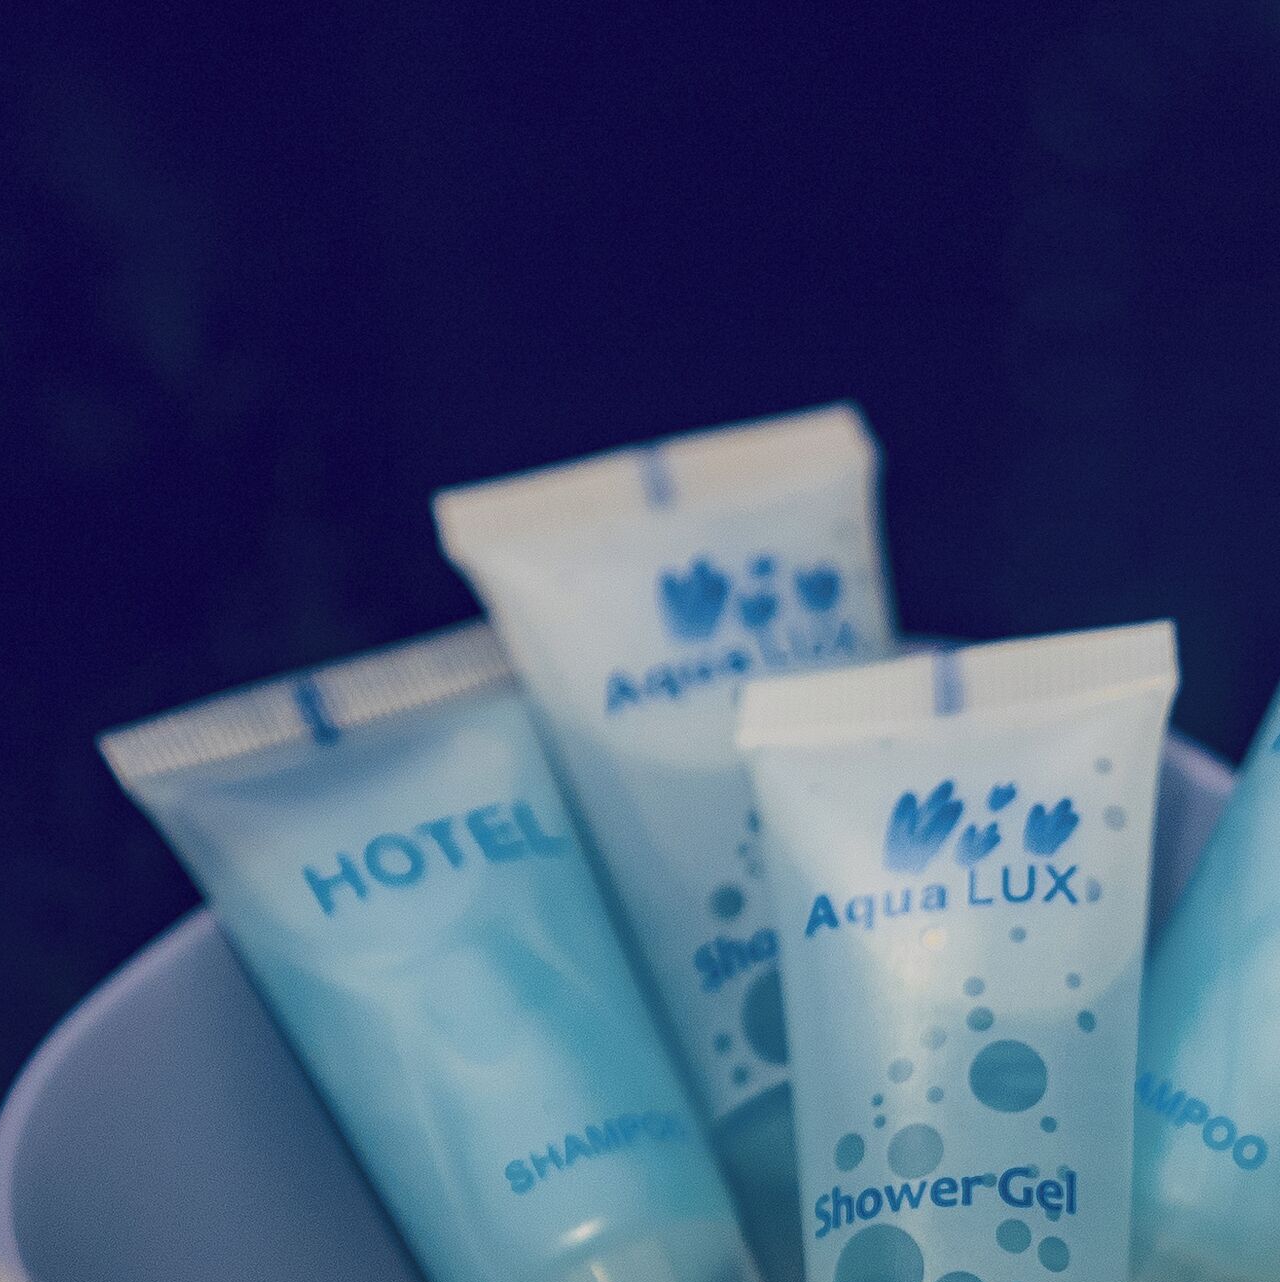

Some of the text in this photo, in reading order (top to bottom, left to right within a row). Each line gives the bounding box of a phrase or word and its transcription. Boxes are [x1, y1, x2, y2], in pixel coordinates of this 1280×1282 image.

[302, 798, 576, 918] HOTEL
[804, 864, 1079, 939] Aqua LUX
[814, 1165, 1078, 1239] Shower Gel
